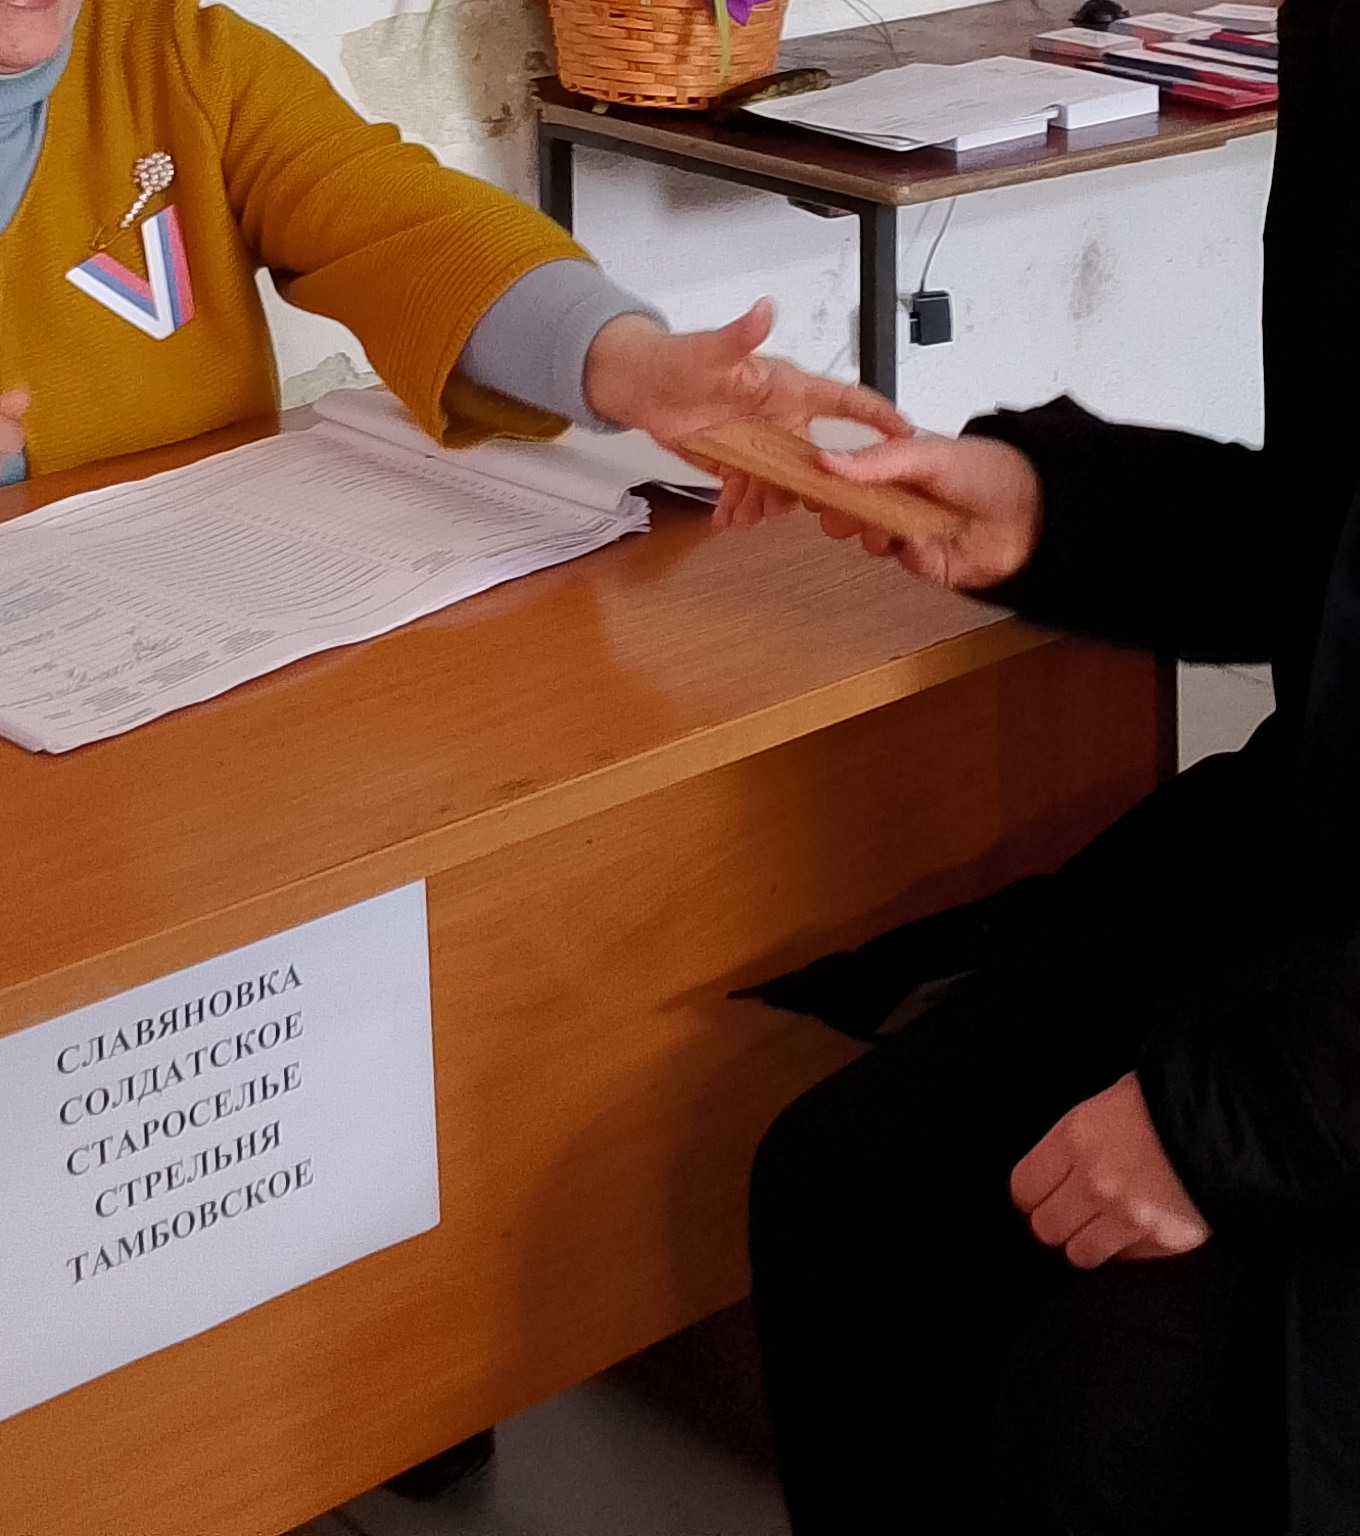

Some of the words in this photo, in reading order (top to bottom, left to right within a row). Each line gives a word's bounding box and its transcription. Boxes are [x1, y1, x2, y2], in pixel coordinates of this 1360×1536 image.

[56, 964, 304, 1076] СЛАВЯНОВКА
[58, 1010, 305, 1127] СОЛДАТСКОЕ
[66, 1062, 303, 1178] СТАРОСЕЛЬЕ
[94, 1121, 282, 1219] СТРЕЛЬНЯ
[66, 1158, 314, 1286] ТАМБОВСКОЕ
